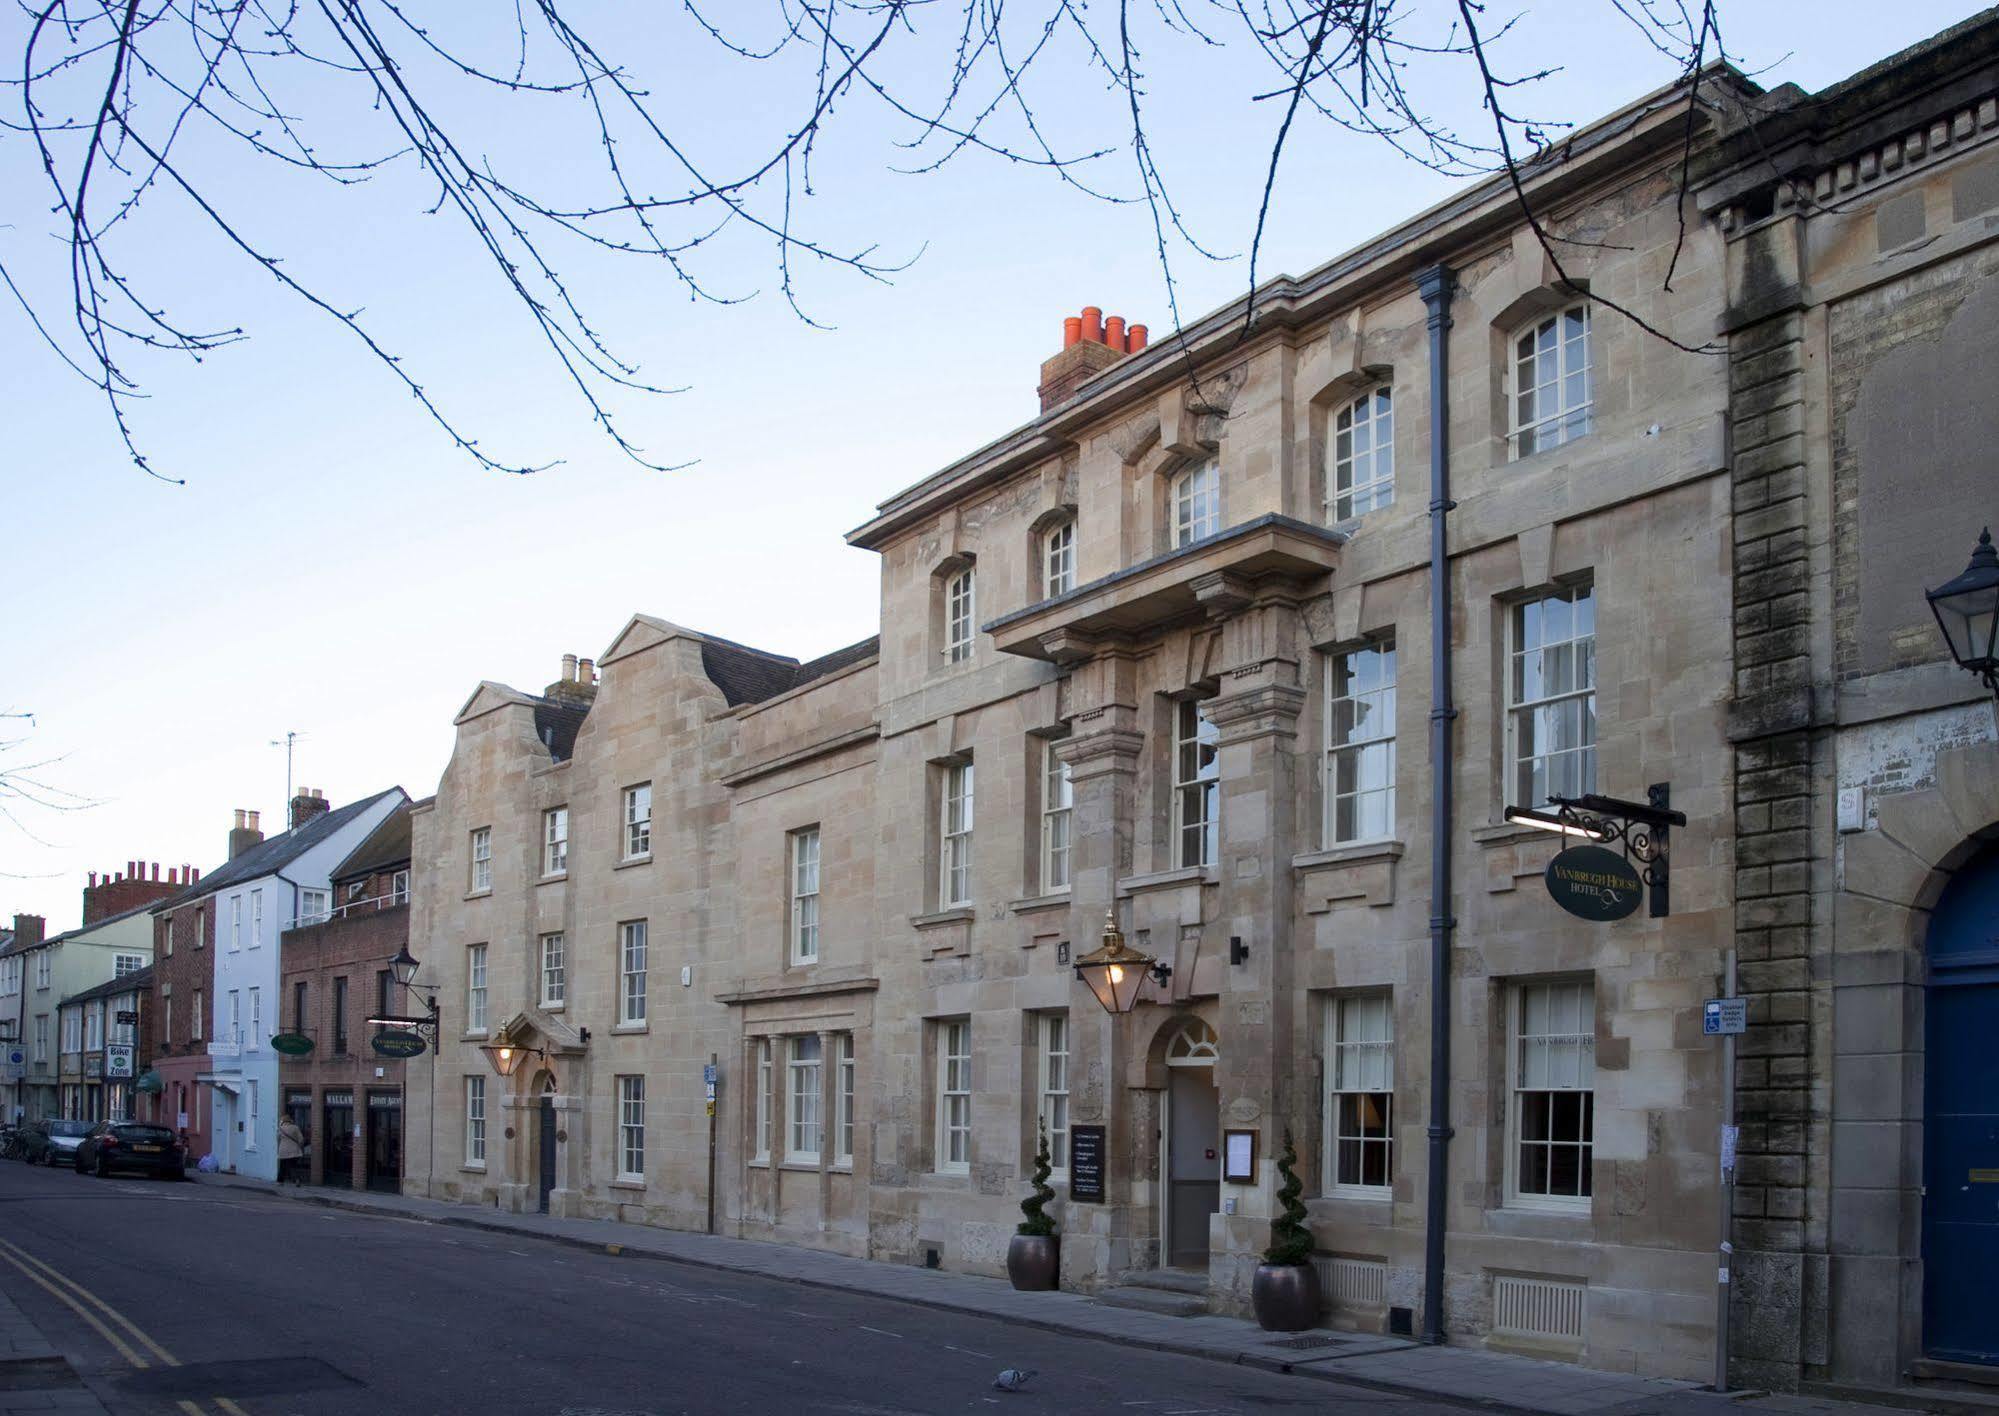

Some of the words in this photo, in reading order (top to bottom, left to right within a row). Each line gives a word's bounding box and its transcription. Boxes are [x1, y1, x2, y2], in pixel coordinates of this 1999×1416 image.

[1554, 865, 1605, 886] VANBRUGH
[1606, 874, 1638, 892] HOUSE
[1570, 882, 1601, 896] HOTEL
